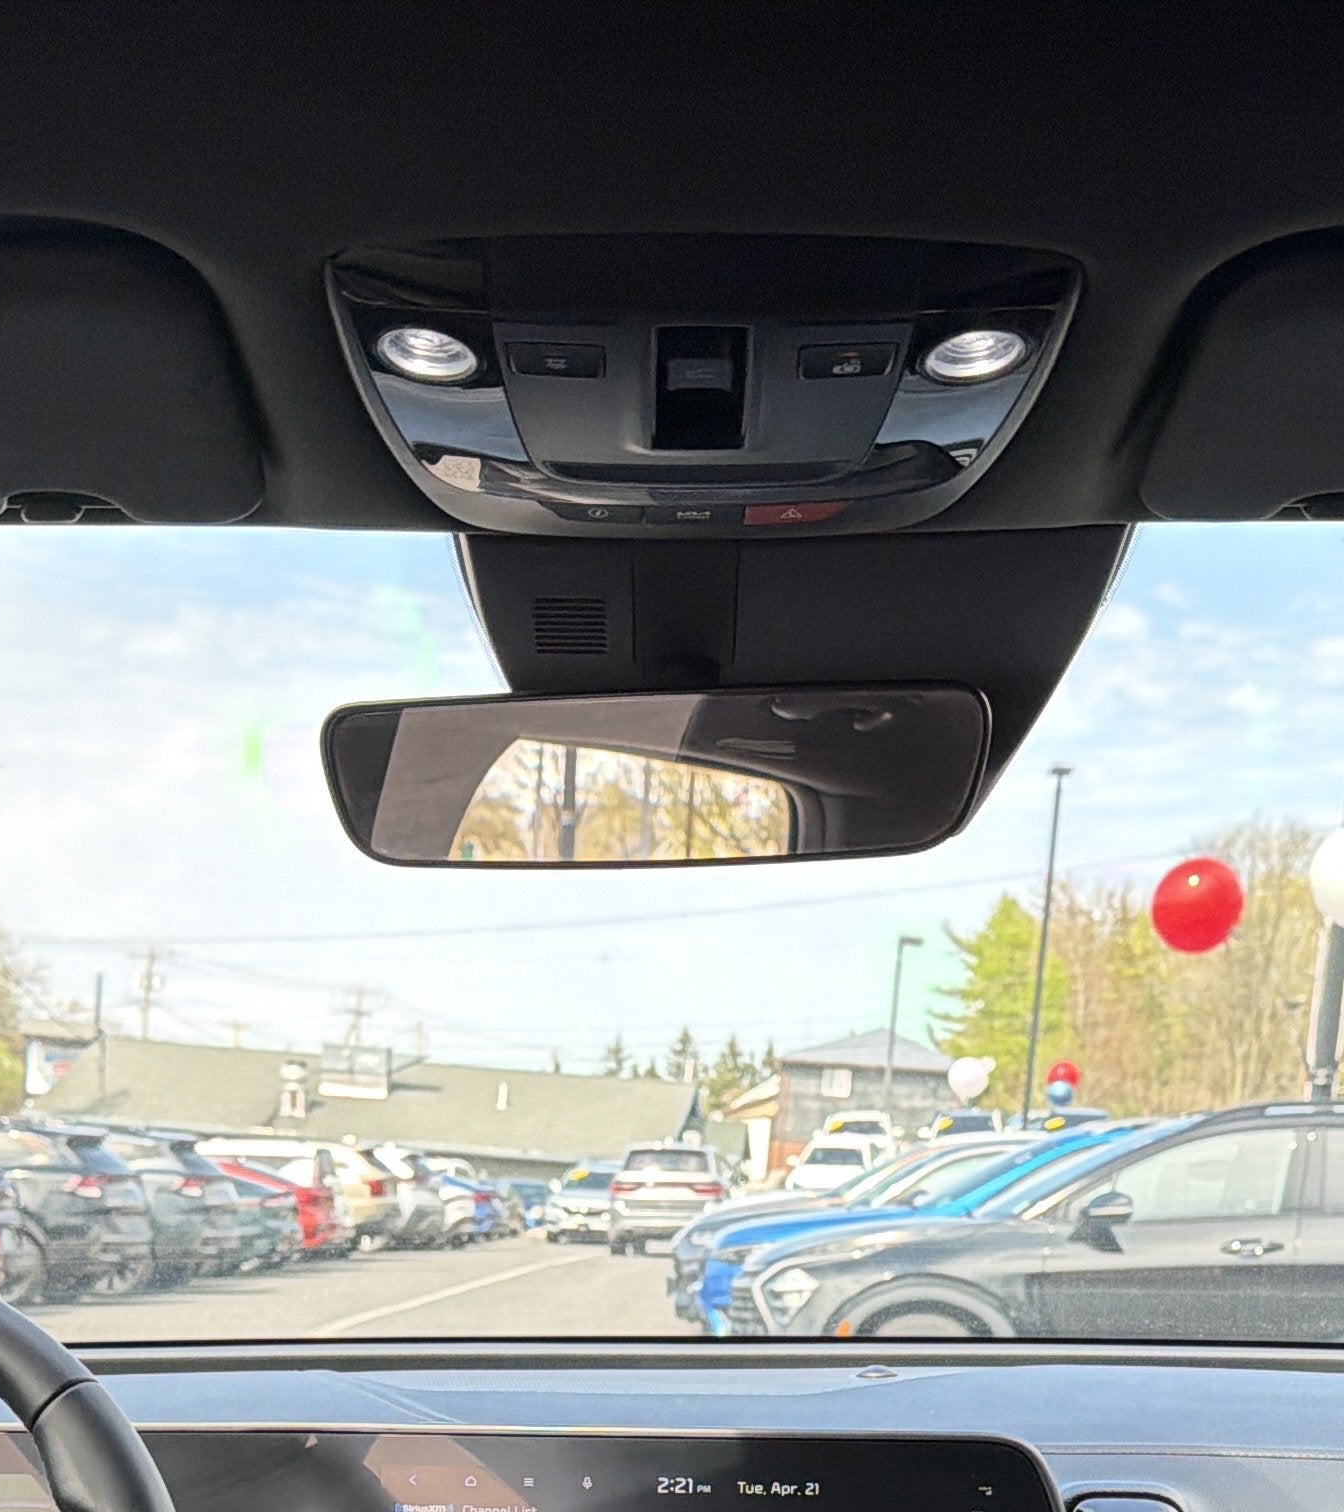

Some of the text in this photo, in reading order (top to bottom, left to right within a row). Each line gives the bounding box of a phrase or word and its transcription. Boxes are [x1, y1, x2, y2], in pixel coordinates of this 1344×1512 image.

[657, 1476, 712, 1494] 2:21 PM
[770, 1482, 802, 1497] Apr.
[805, 1483, 820, 1496] 21
